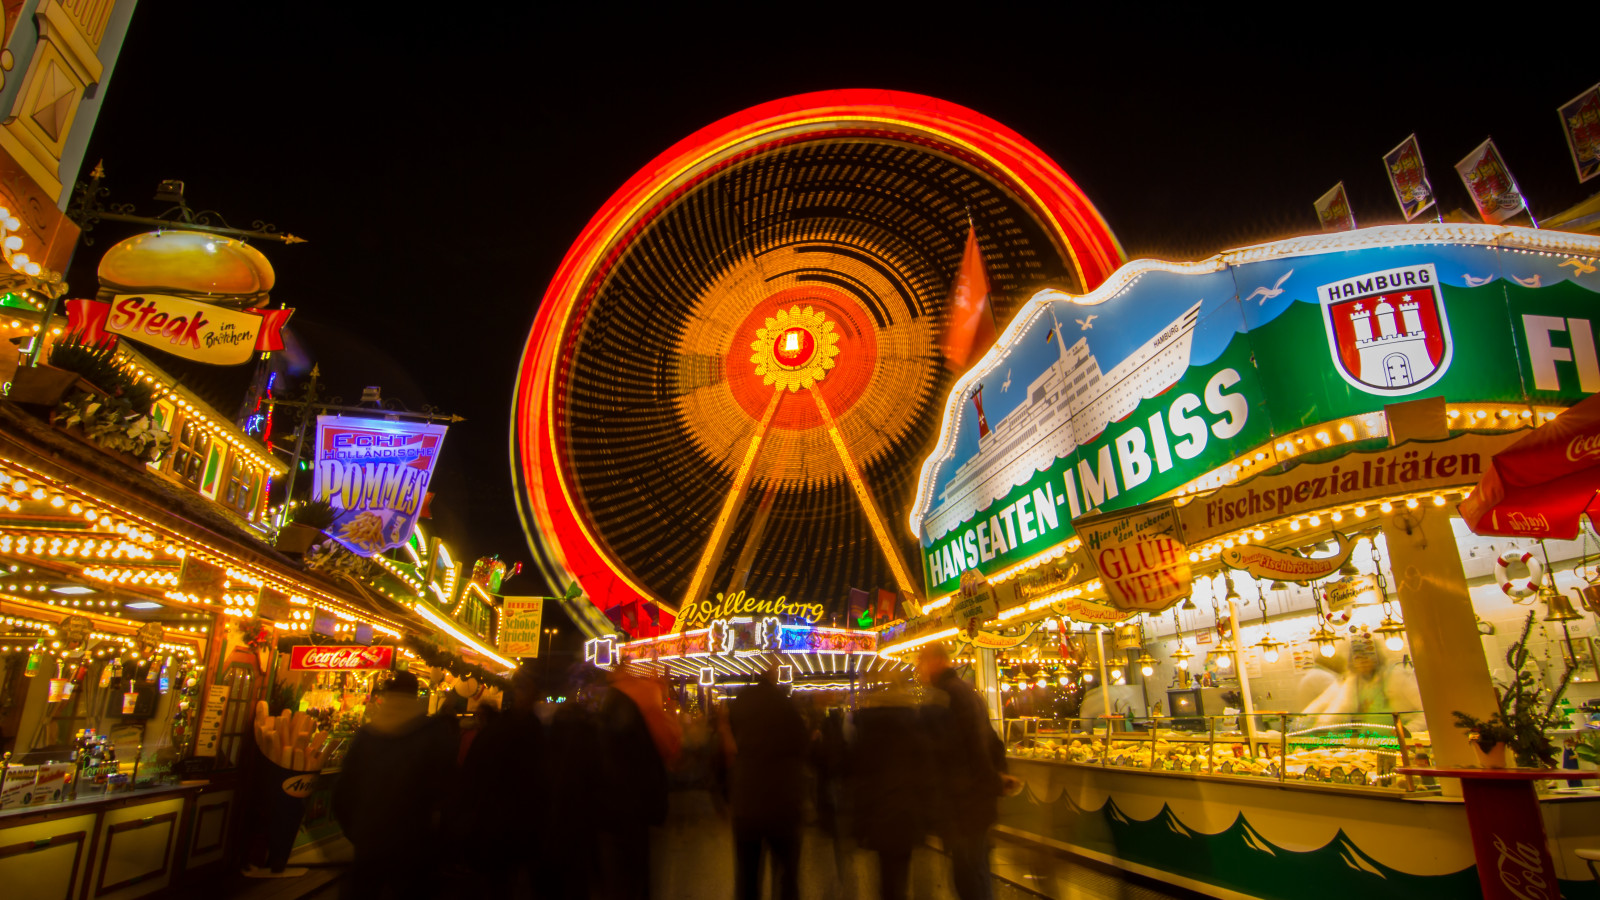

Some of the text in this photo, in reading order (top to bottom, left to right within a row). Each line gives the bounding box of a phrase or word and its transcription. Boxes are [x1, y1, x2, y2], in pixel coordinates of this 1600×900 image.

[1328, 269, 1430, 301] HAMBURG
[110, 297, 209, 349] Steak
[220, 322, 235, 331] im
[1153, 324, 1179, 348] HAMBURG
[324, 447, 434, 459] HOLLÄNDISCHE
[334, 434, 413, 447] ECHT
[320, 459, 430, 516] POMMES
[929, 368, 1249, 587] HANSEATEN-IMBISS
[1206, 450, 1482, 528] Fischspezialitäten
[1099, 534, 1180, 580] GLÜH-
[1259, 555, 1332, 574] Fischbrötchen
[1114, 566, 1181, 606] WEIN
[505, 618, 538, 630] Schoko-
[675, 590, 824, 626] Willenborg
[302, 648, 364, 668] Coca-Cola
